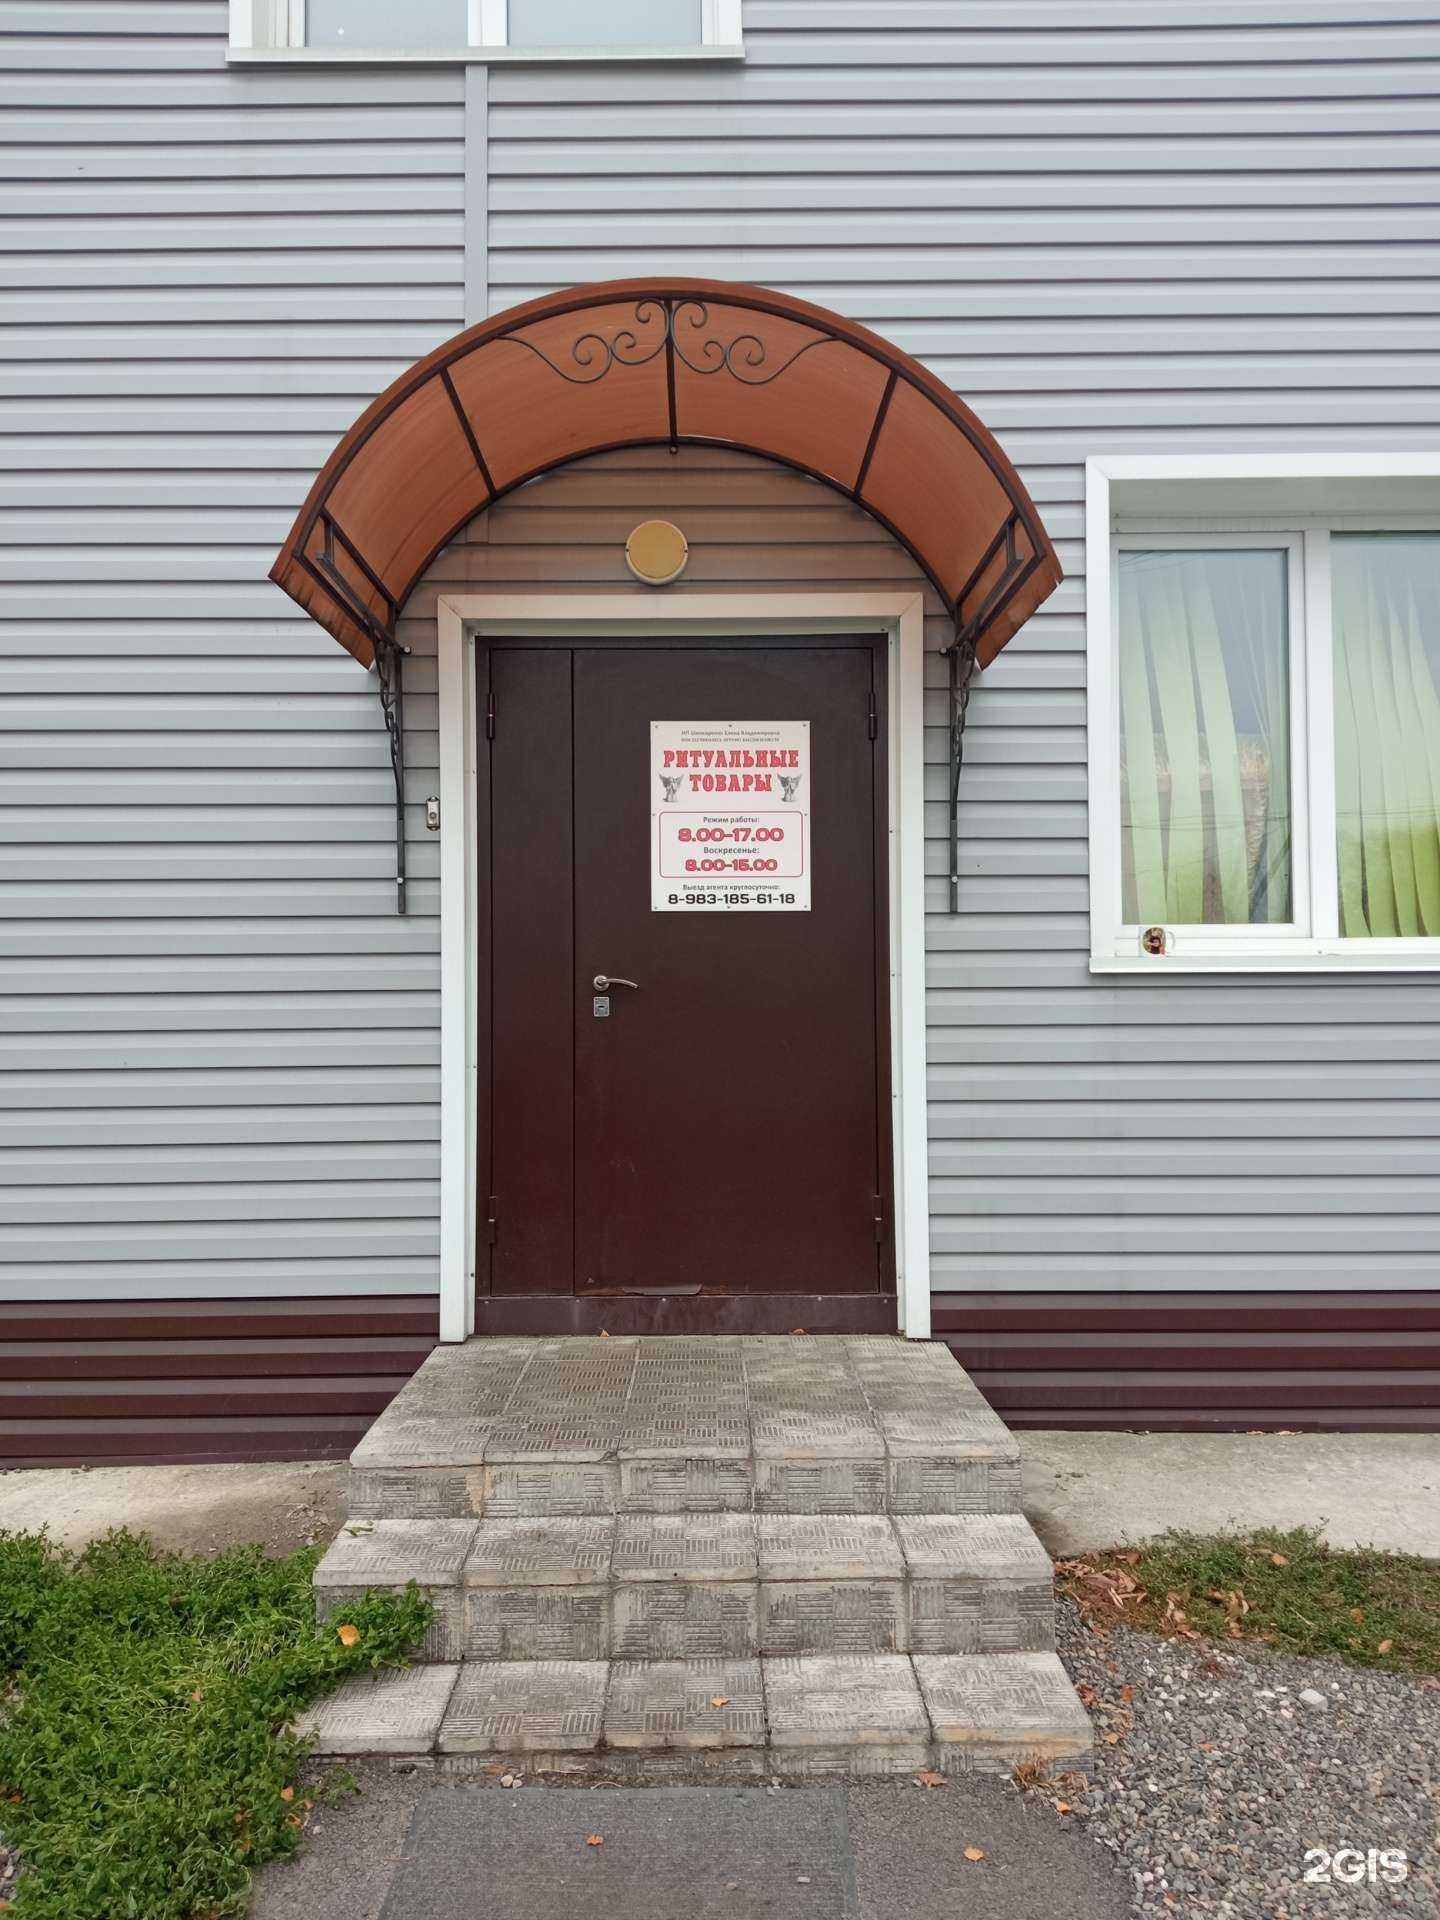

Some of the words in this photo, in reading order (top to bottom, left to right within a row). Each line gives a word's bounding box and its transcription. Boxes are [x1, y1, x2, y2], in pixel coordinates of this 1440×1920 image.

[663, 750, 799, 768] РИТУАЛЬНЫЕ
[689, 774, 772, 792] ТОВАРЫ
[730, 816, 760, 824] работы:
[678, 828, 784, 842] 8.00-17.00
[703, 846, 760, 855] Воскресенье:
[685, 859, 777, 871] 8.00-15.00
[668, 893, 795, 904] 8-983-185-61-18
